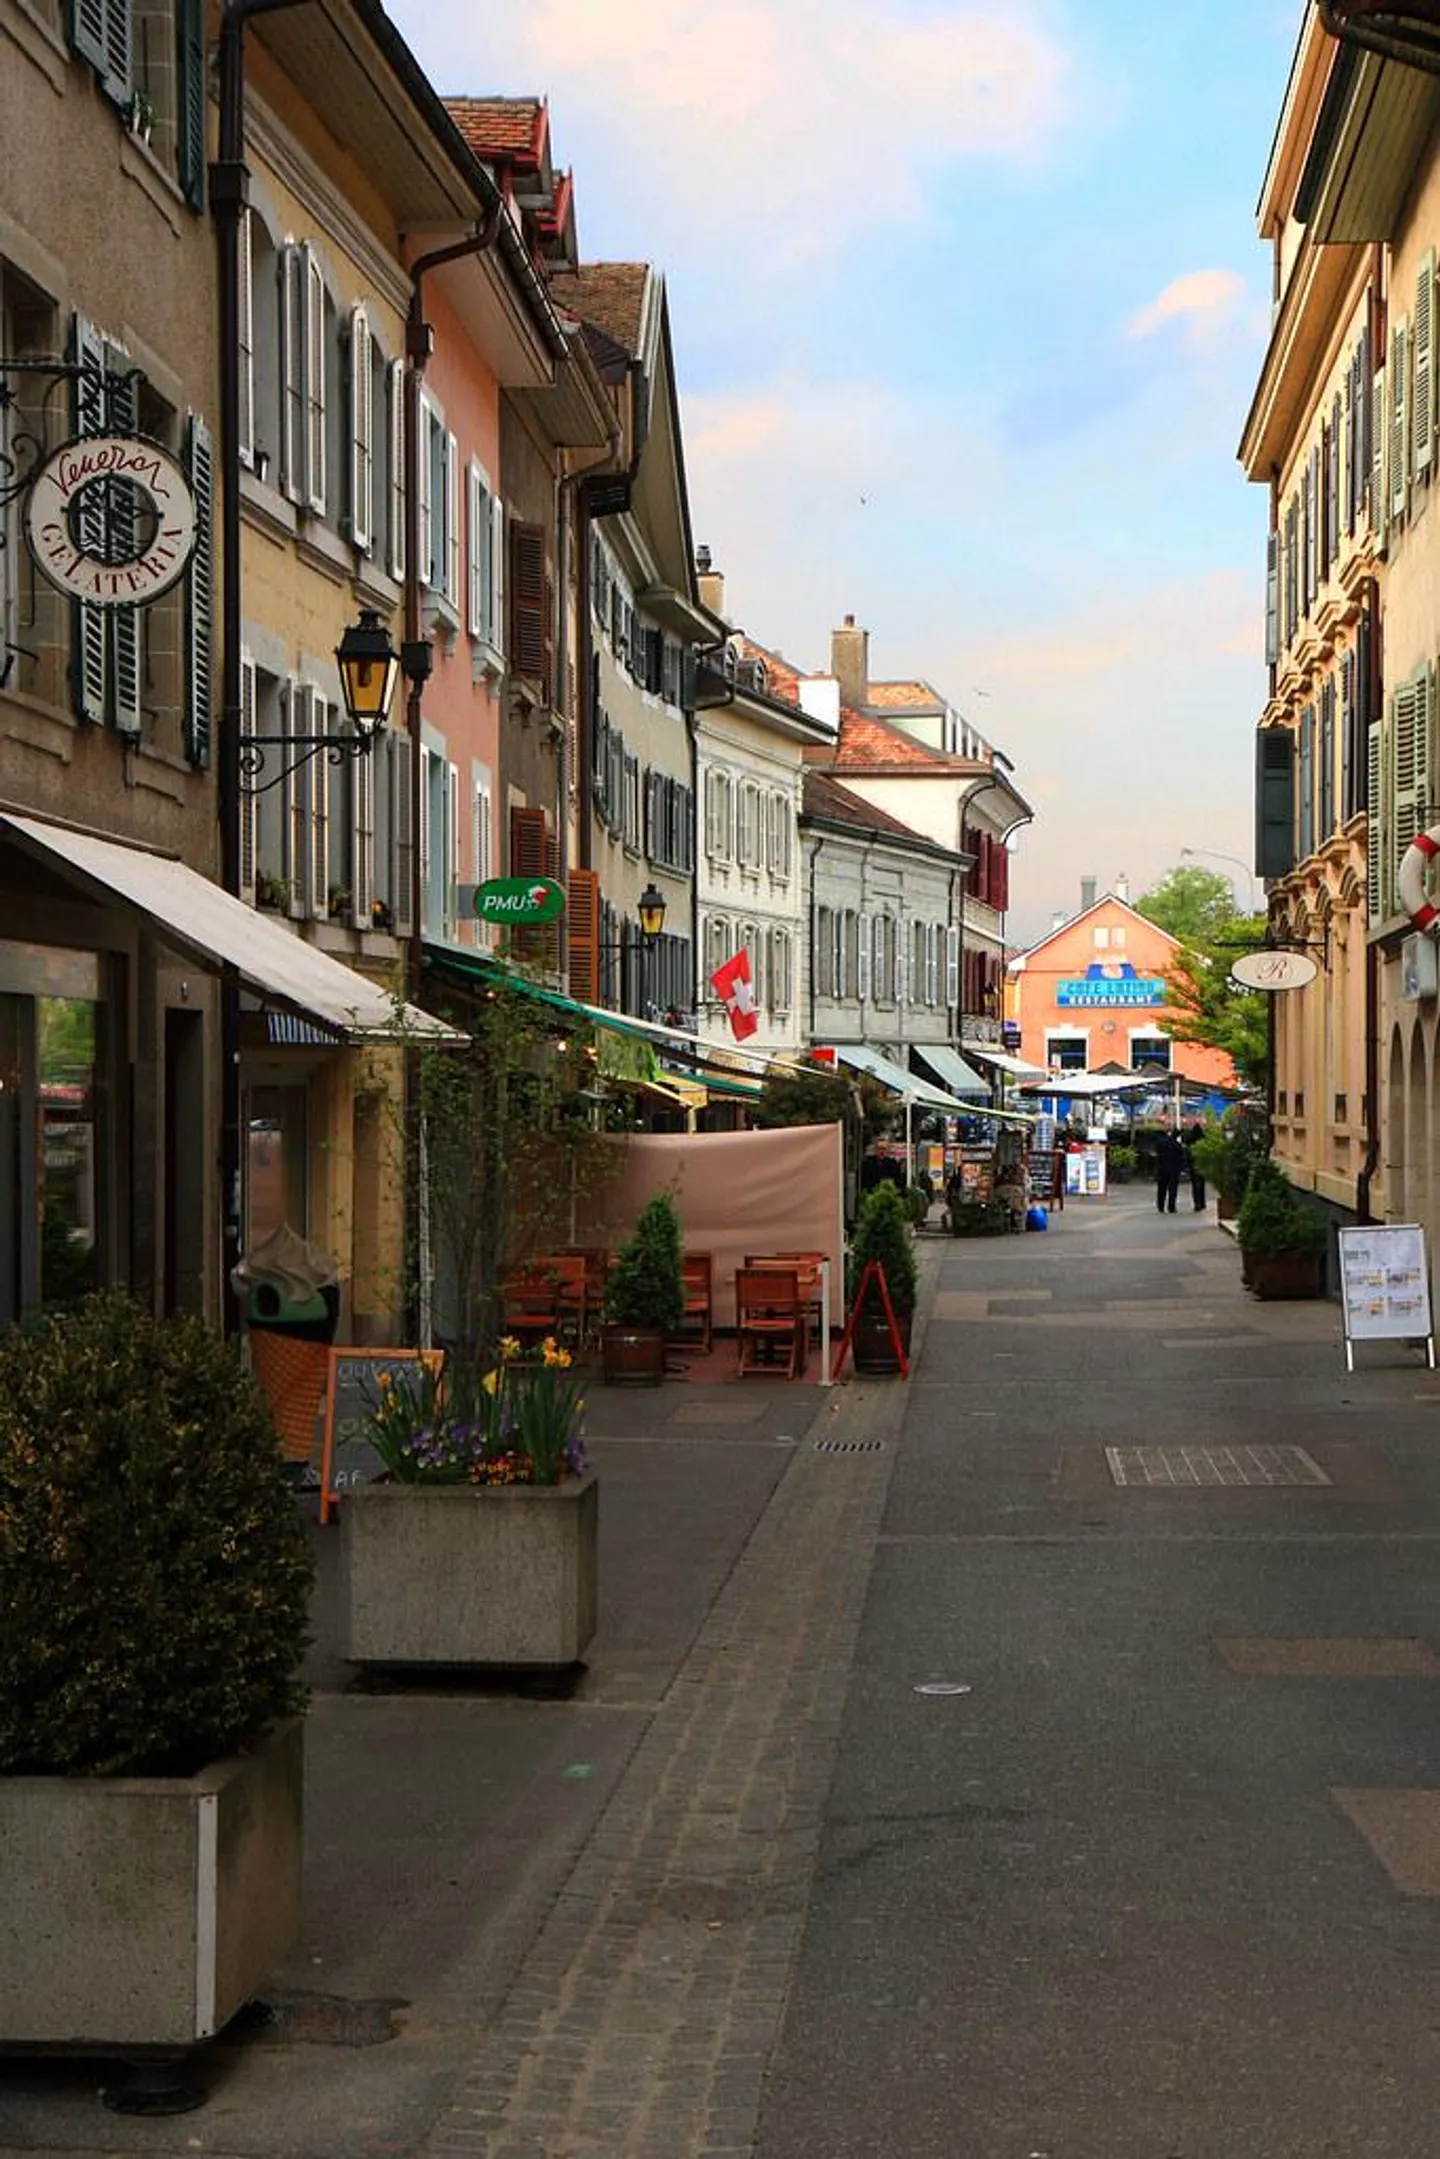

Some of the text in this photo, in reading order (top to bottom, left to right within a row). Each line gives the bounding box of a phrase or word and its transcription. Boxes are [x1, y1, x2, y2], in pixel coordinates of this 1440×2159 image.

[41, 523, 183, 594] GELATERIA
[483, 896, 524, 911] PMU
[1068, 995, 1152, 1005] RESTAURANT
